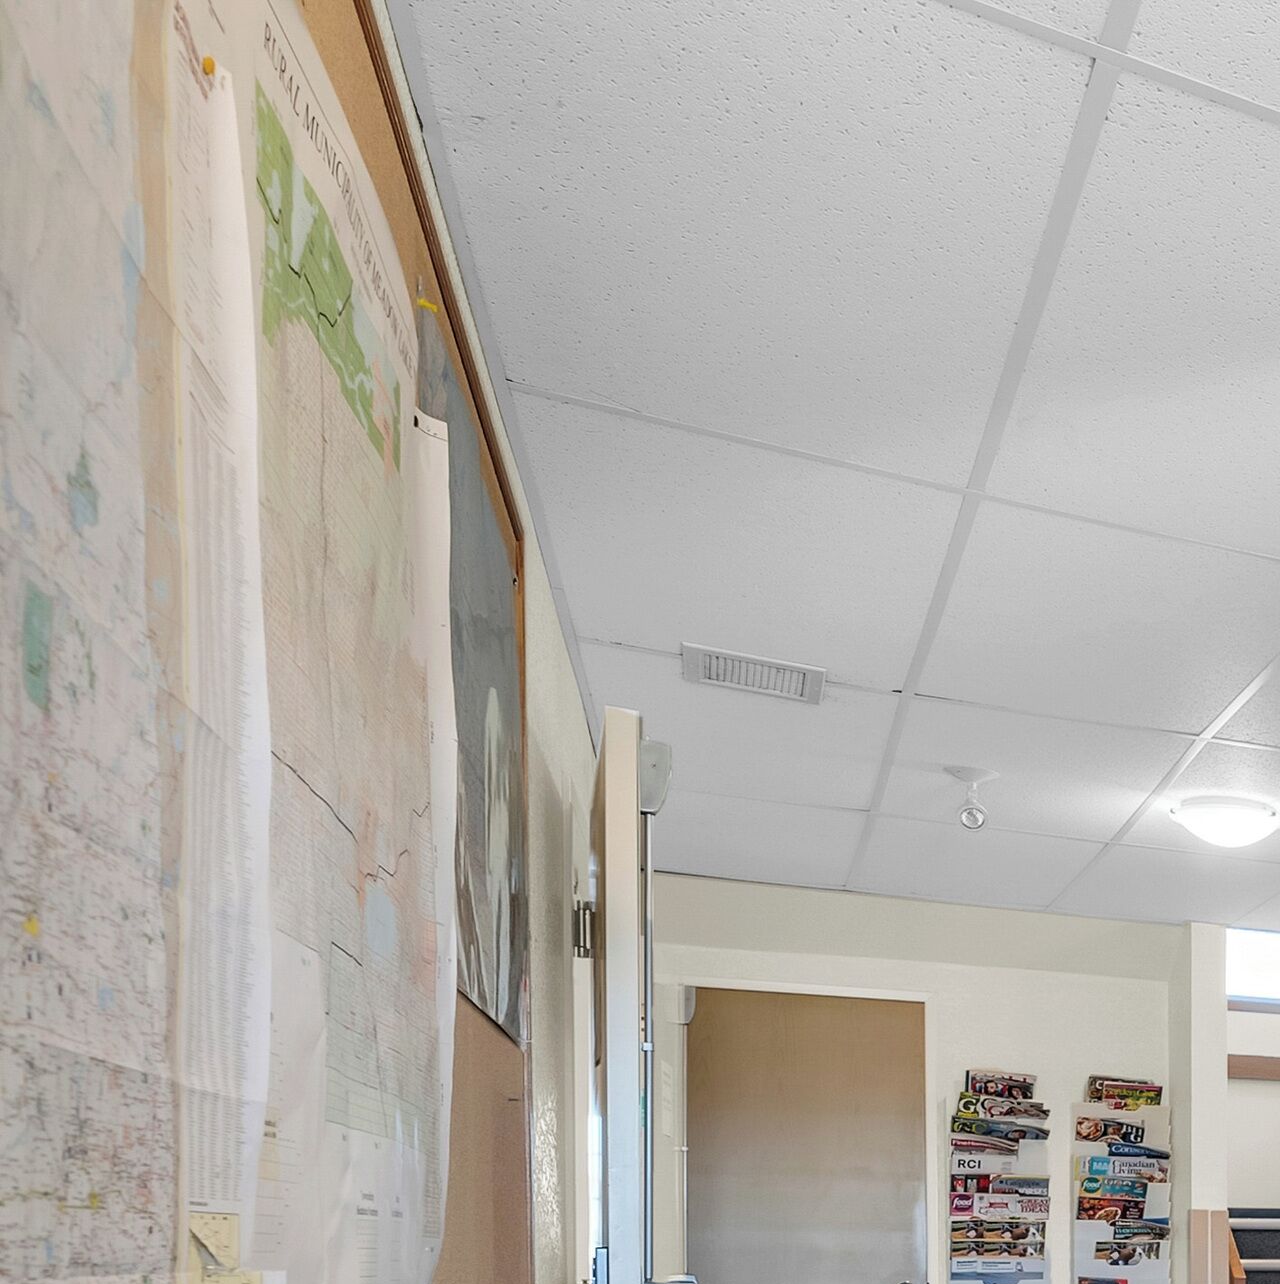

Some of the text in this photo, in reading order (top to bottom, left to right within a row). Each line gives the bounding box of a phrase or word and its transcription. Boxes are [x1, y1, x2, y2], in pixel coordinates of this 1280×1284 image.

[263, 22, 300, 117] RURAL
[957, 1159, 982, 1169] RCI
[1112, 1159, 1156, 1168] Canadian
[952, 1197, 973, 1208] food
